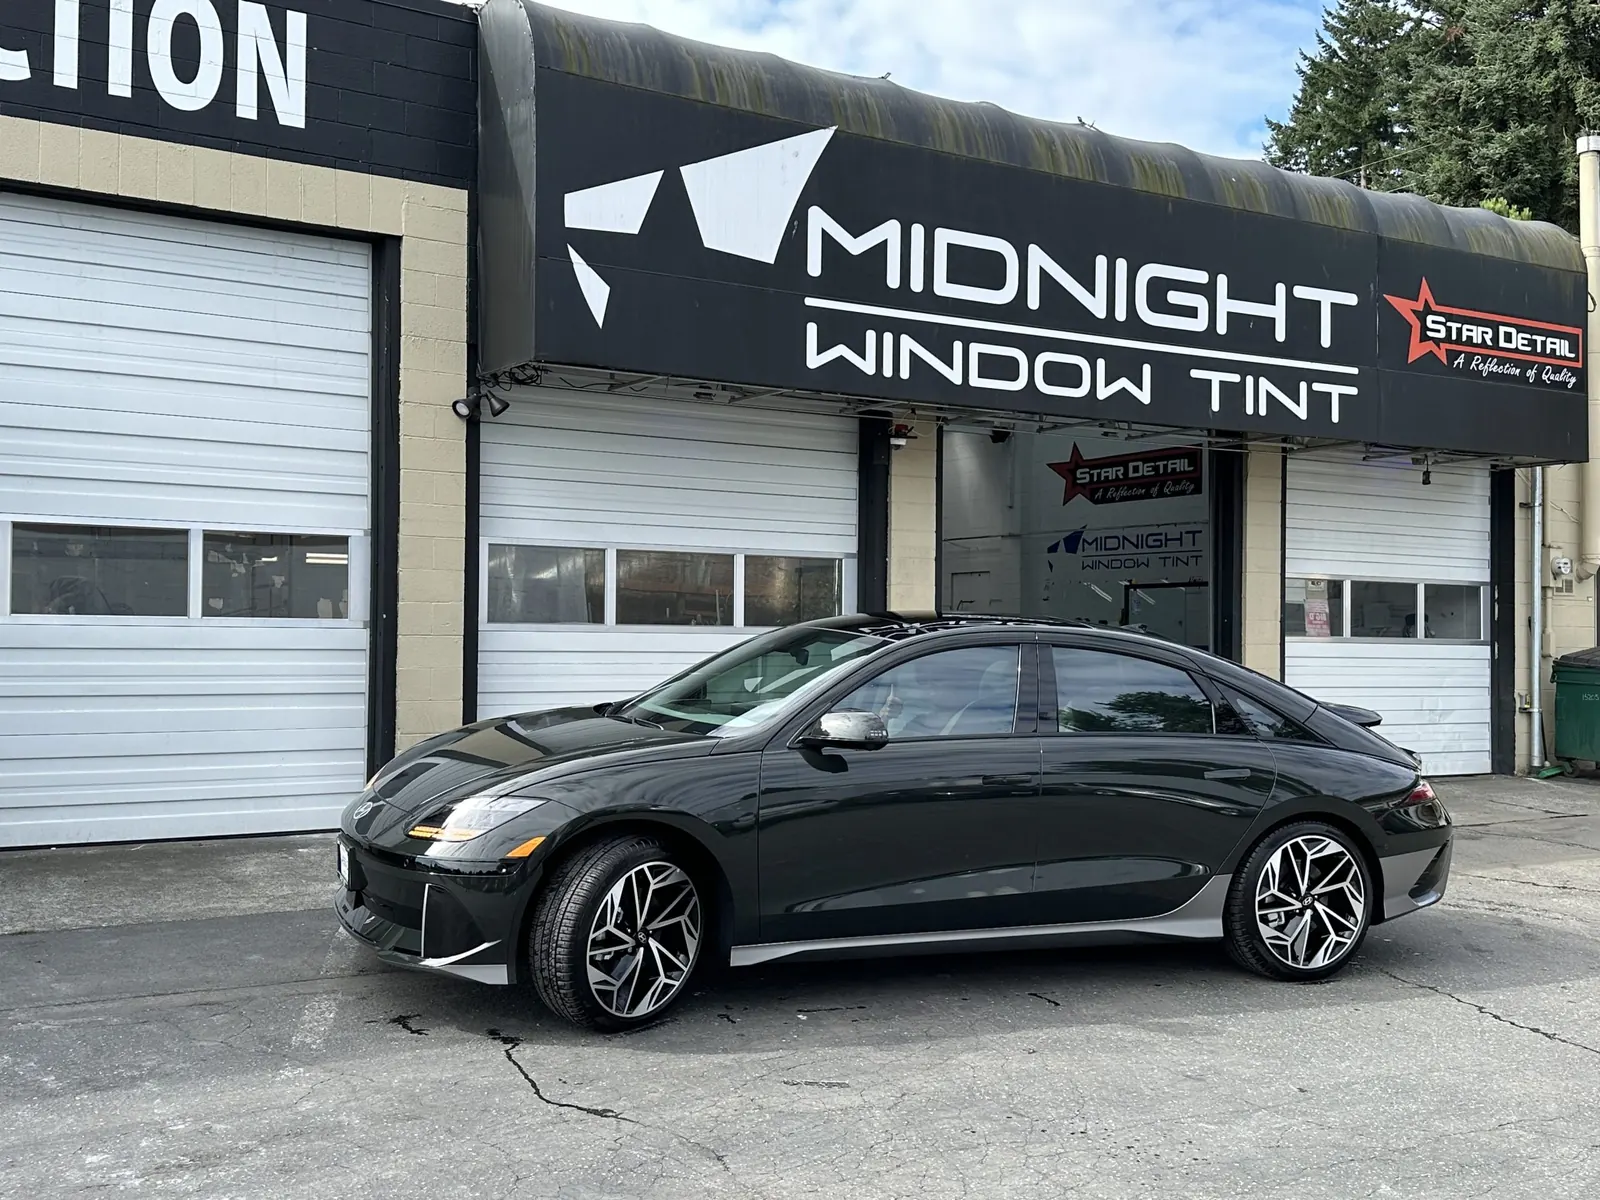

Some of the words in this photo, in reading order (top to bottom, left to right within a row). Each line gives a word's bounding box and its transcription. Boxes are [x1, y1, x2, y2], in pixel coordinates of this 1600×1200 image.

[0, 0, 307, 129] TION
[807, 205, 1358, 349] MIDNIGHT
[1426, 314, 1493, 346] STAR
[1498, 325, 1576, 358] DETAIL
[806, 321, 1151, 404] WINDOW
[1190, 368, 1358, 423] TINT
[1453, 353, 1465, 368] A
[1469, 355, 1521, 377] Reflection
[1525, 364, 1537, 383] of
[1541, 366, 1577, 388] Quality
[1076, 466, 1124, 484] STAR
[1128, 458, 1194, 478] DETAIL
[1094, 489, 1103, 499] A
[1106, 487, 1146, 500] Reflection
[1150, 482, 1161, 496] of
[1163, 480, 1195, 493] Quality
[1081, 530, 1203, 552] MIDNIGHT
[1081, 556, 1149, 570] WINDOW
[1158, 555, 1203, 568] TINT
